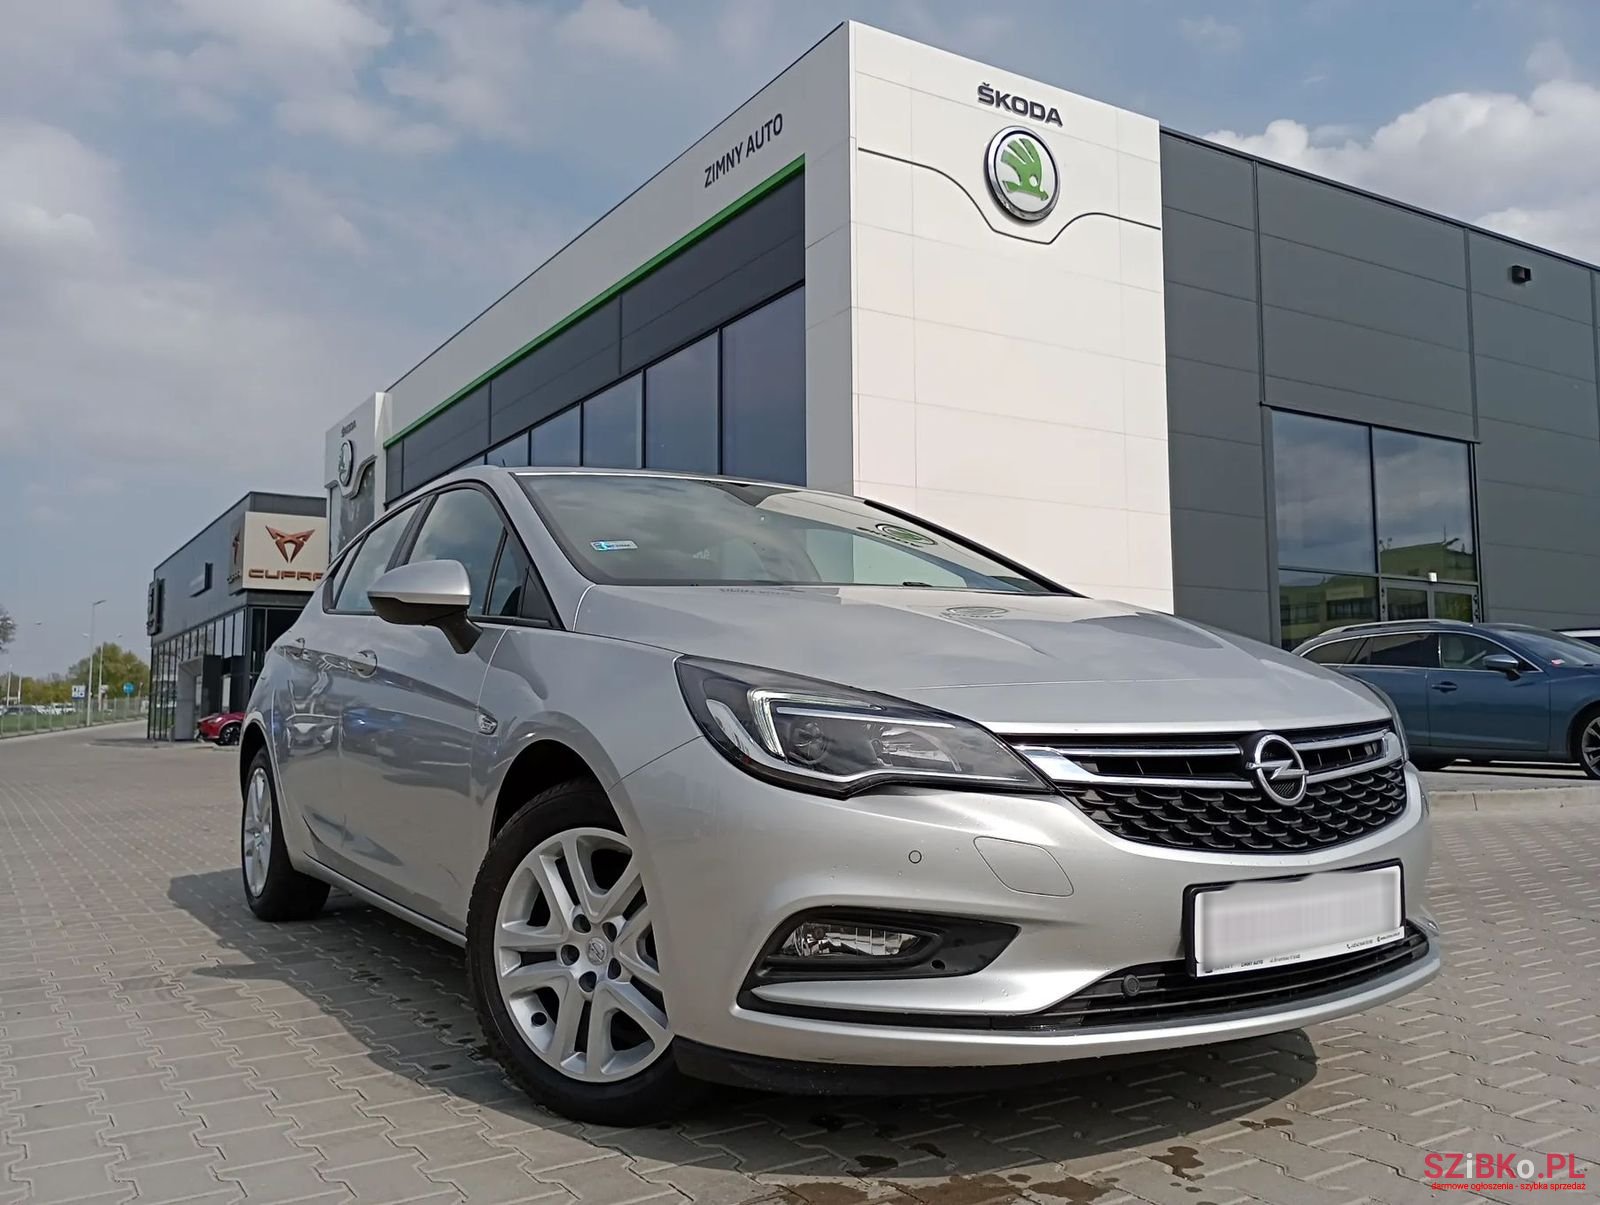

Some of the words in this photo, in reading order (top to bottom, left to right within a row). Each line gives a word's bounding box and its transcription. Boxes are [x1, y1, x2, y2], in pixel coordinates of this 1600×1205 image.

[977, 82, 1063, 127] ŠKODA
[704, 147, 743, 188] ZIMNY
[746, 113, 783, 159] AUTO
